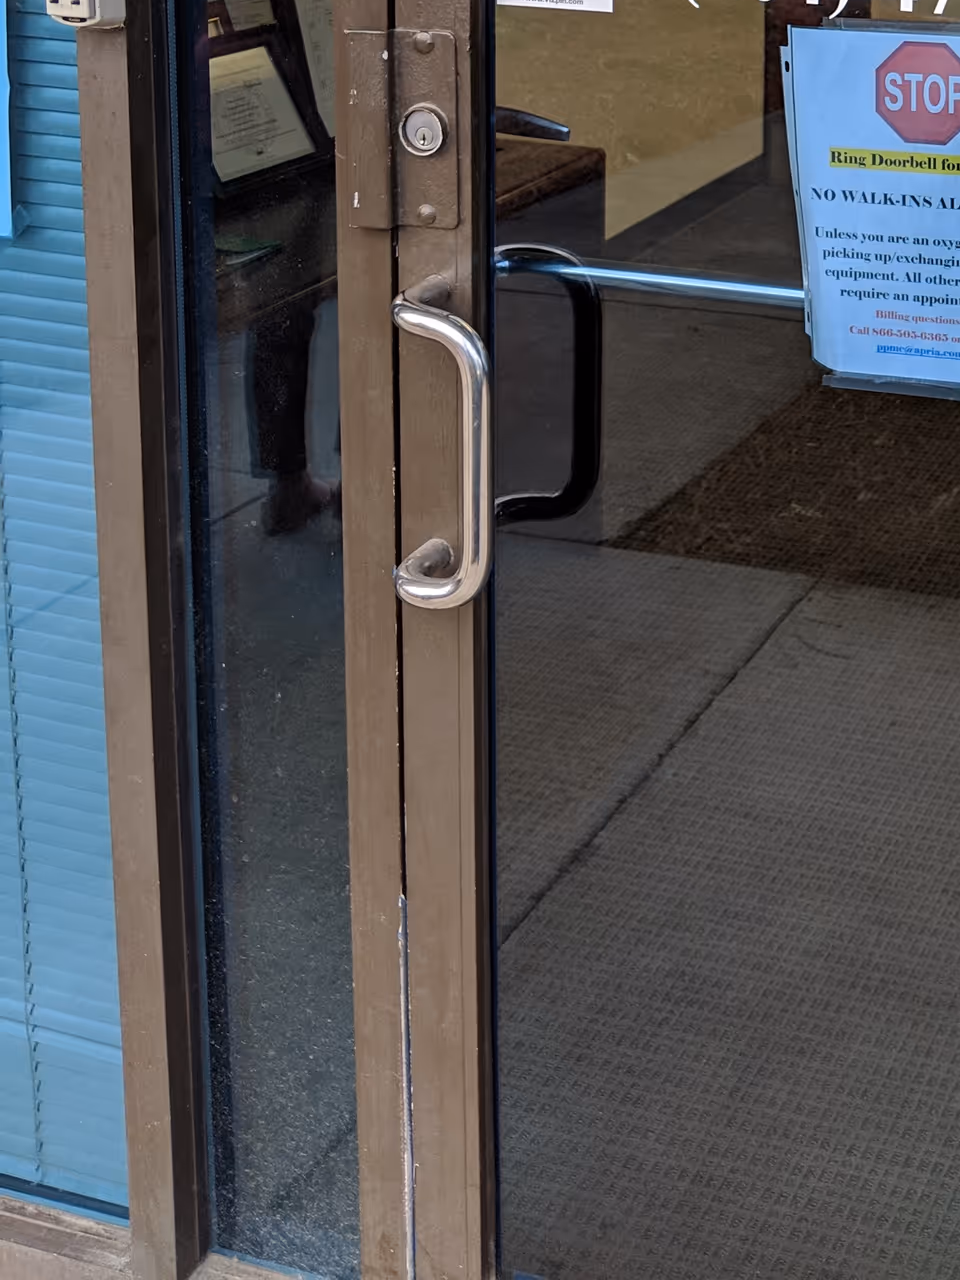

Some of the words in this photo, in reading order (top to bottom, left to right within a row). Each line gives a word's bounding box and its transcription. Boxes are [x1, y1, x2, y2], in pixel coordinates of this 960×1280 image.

[830, 150, 867, 168] Ring
[871, 153, 937, 170] Doorbell
[810, 187, 836, 202] NO
[841, 189, 932, 209] WALK-INS
[815, 226, 858, 240] Unless
[861, 231, 884, 244] you
[887, 234, 910, 245] are
[912, 236, 929, 246] an
[822, 248, 871, 262] picking
[825, 267, 899, 283] equipment.
[902, 272, 922, 284] All
[839, 288, 890, 301] require
[893, 291, 909, 303] an
[875, 309, 910, 323] Billing
[849, 325, 870, 336] Call
